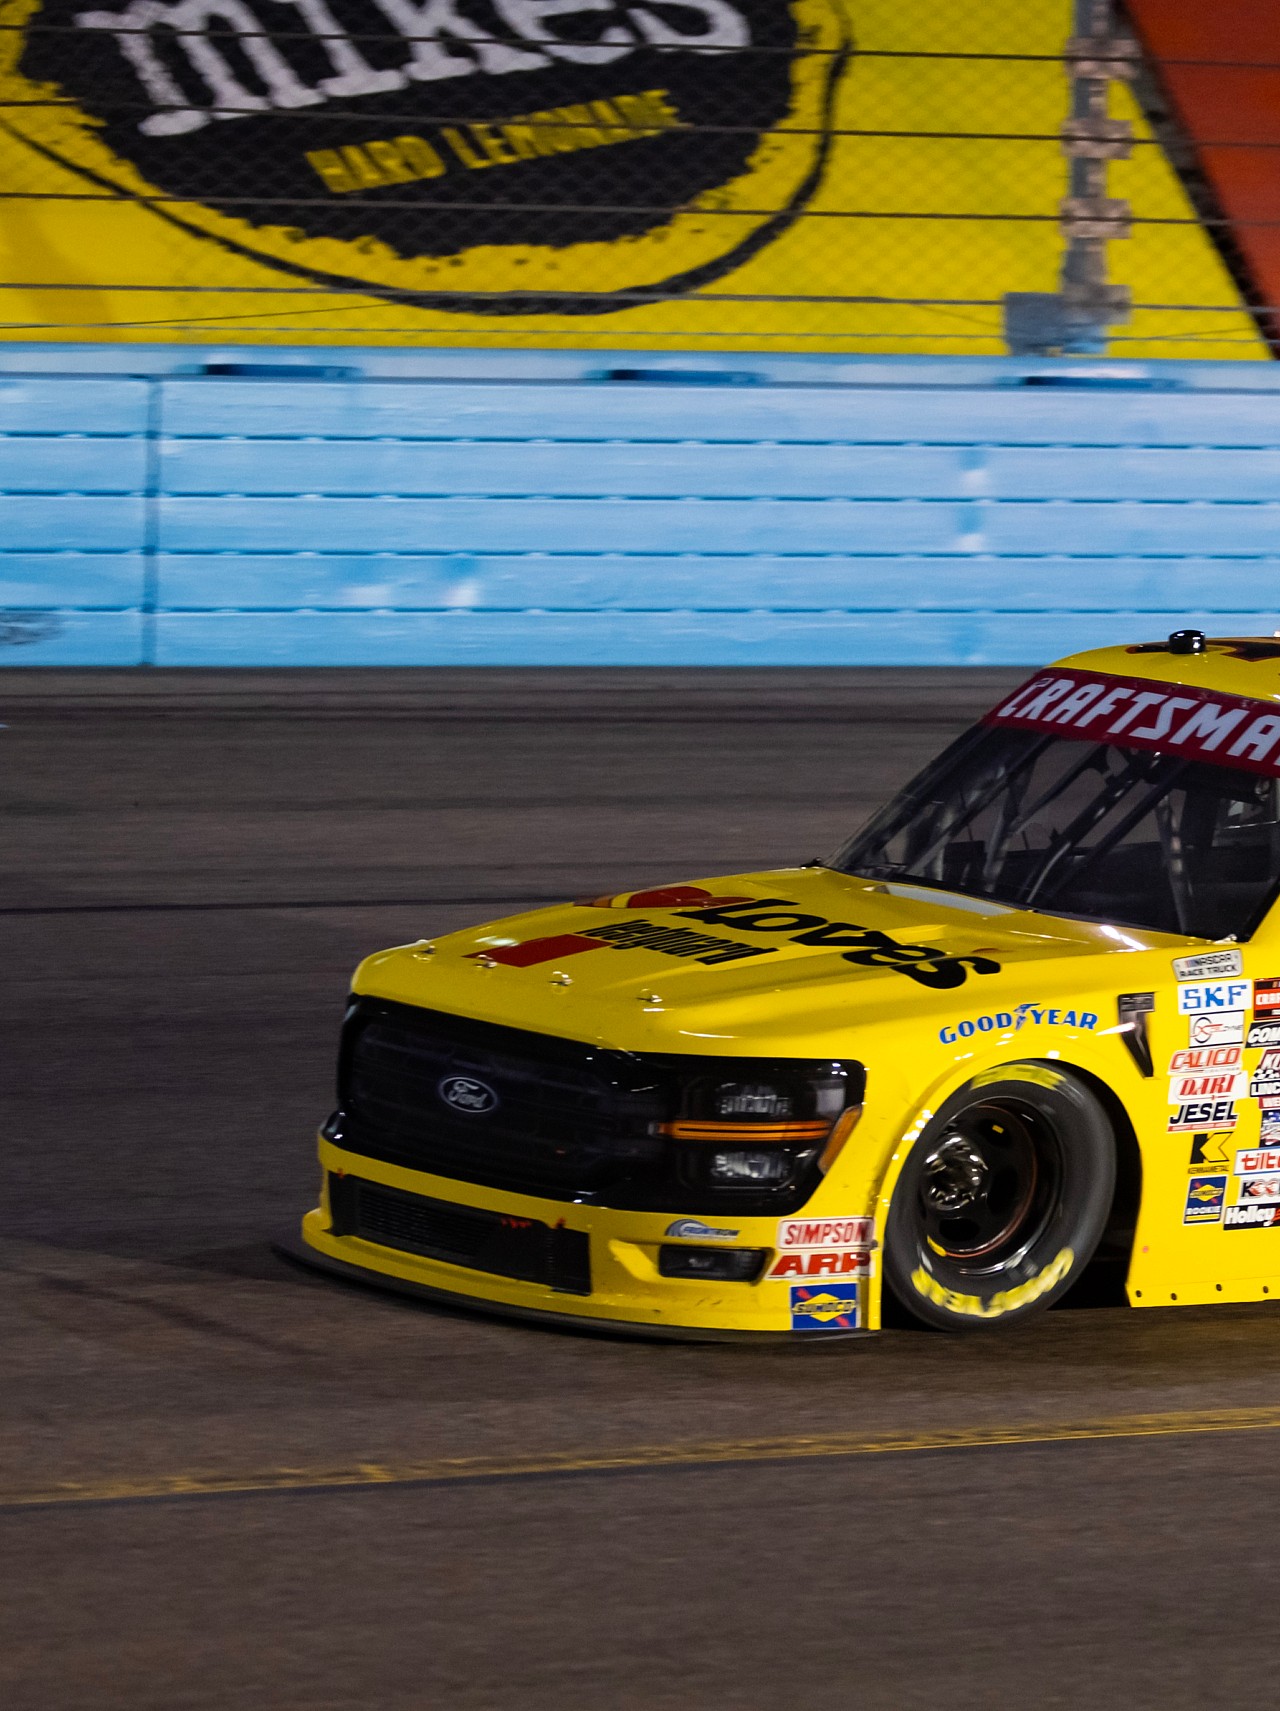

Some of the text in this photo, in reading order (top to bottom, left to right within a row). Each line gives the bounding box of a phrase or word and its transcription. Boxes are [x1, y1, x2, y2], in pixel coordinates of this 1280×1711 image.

[306, 136, 447, 193] HARD
[671, 898, 1001, 990] Loves
[1180, 964, 1238, 977] RACE TRUCK
[1183, 984, 1248, 1010] SKF
[1170, 1047, 1241, 1070] CALICO
[1169, 1101, 1238, 1125] JESEL
[1224, 1205, 1276, 1227] Holley
[784, 1221, 870, 1246] SIMPSON
[769, 1251, 871, 1277] ARP
